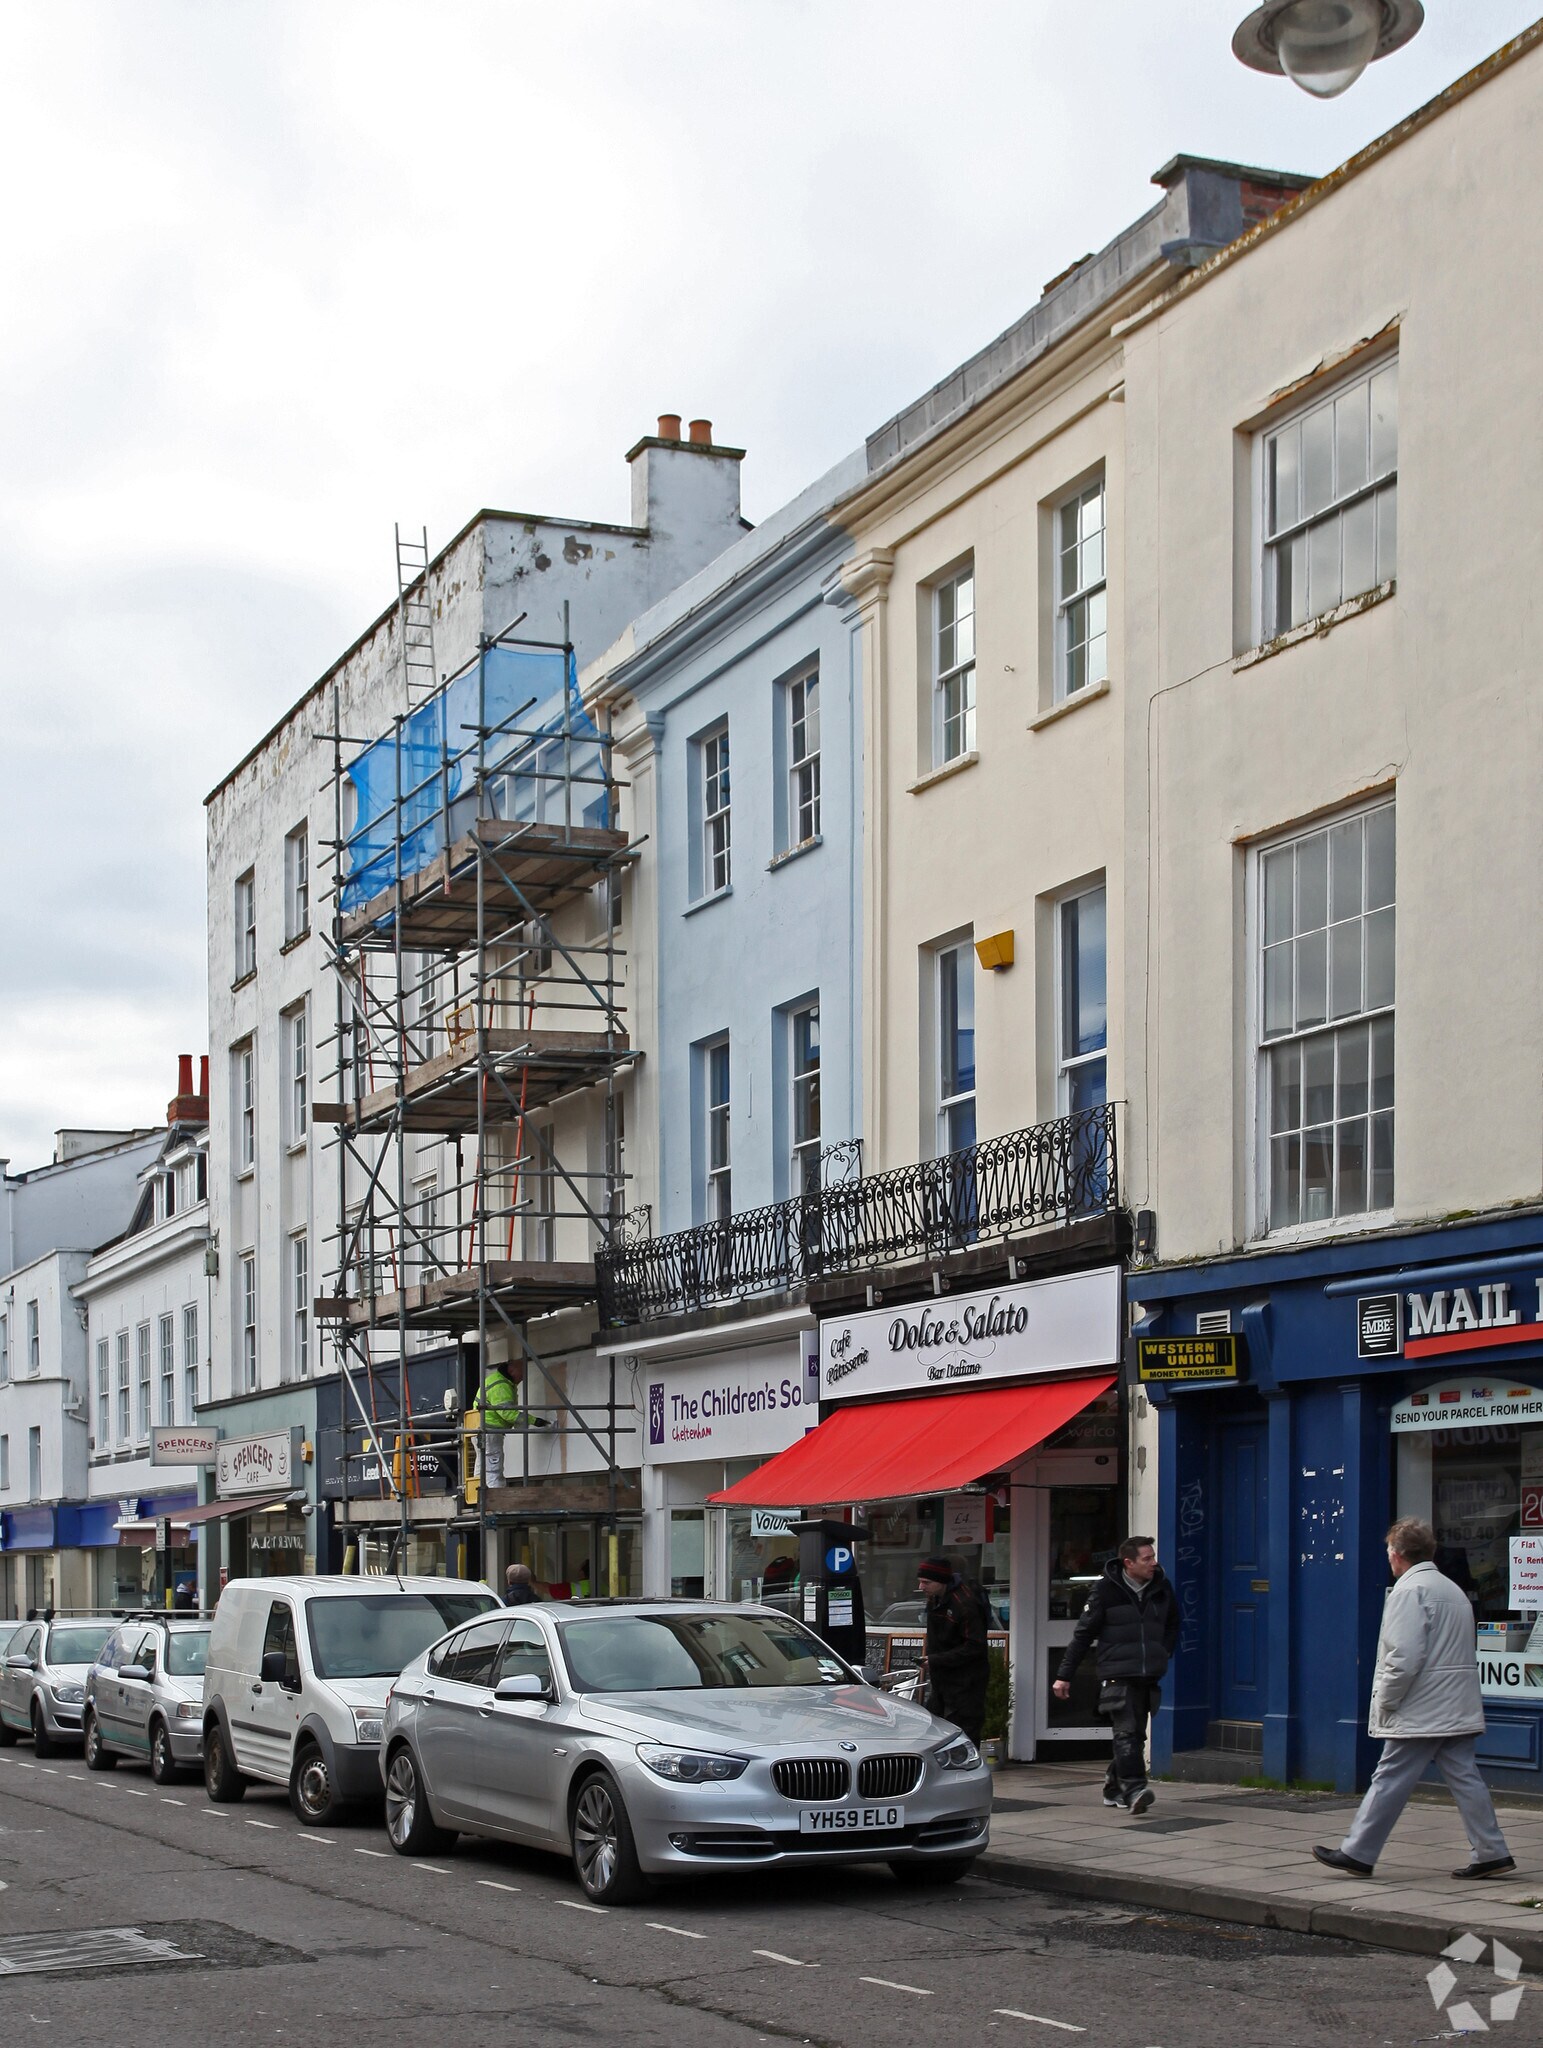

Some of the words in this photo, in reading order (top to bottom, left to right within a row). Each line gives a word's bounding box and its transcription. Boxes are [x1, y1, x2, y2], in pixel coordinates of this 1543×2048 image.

[1408, 1282, 1520, 1336] MAIL
[887, 1307, 945, 1352] Dolce
[944, 1319, 959, 1344] &
[957, 1295, 1029, 1345] Salato
[1365, 1319, 1391, 1334] MBE
[1144, 1342, 1215, 1355] WESTERN
[927, 1365, 945, 1380] Bar
[946, 1359, 982, 1378] Italiano
[1167, 1354, 1215, 1366] UNION
[1149, 1370, 1179, 1378] MONEY
[1182, 1368, 1226, 1377] TRANSFER
[671, 1394, 698, 1421] The
[701, 1382, 776, 1418] Children's
[1471, 1387, 1493, 1399] FedEx
[1395, 1412, 1420, 1424] SEND
[1423, 1409, 1449, 1422] YOUR
[1450, 1406, 1488, 1420] PARCEL
[1490, 1403, 1519, 1417] FROM
[671, 1422, 712, 1442] Cheltenham
[157, 1438, 214, 1451] SPENCERS
[233, 1443, 273, 1477] SPENCERS
[246, 1471, 259, 1484] CAFE
[834, 1547, 850, 1571] P
[1521, 1571, 1537, 1579] Large
[1477, 1661, 1519, 1686] ING
[810, 1810, 858, 1829] YH59
